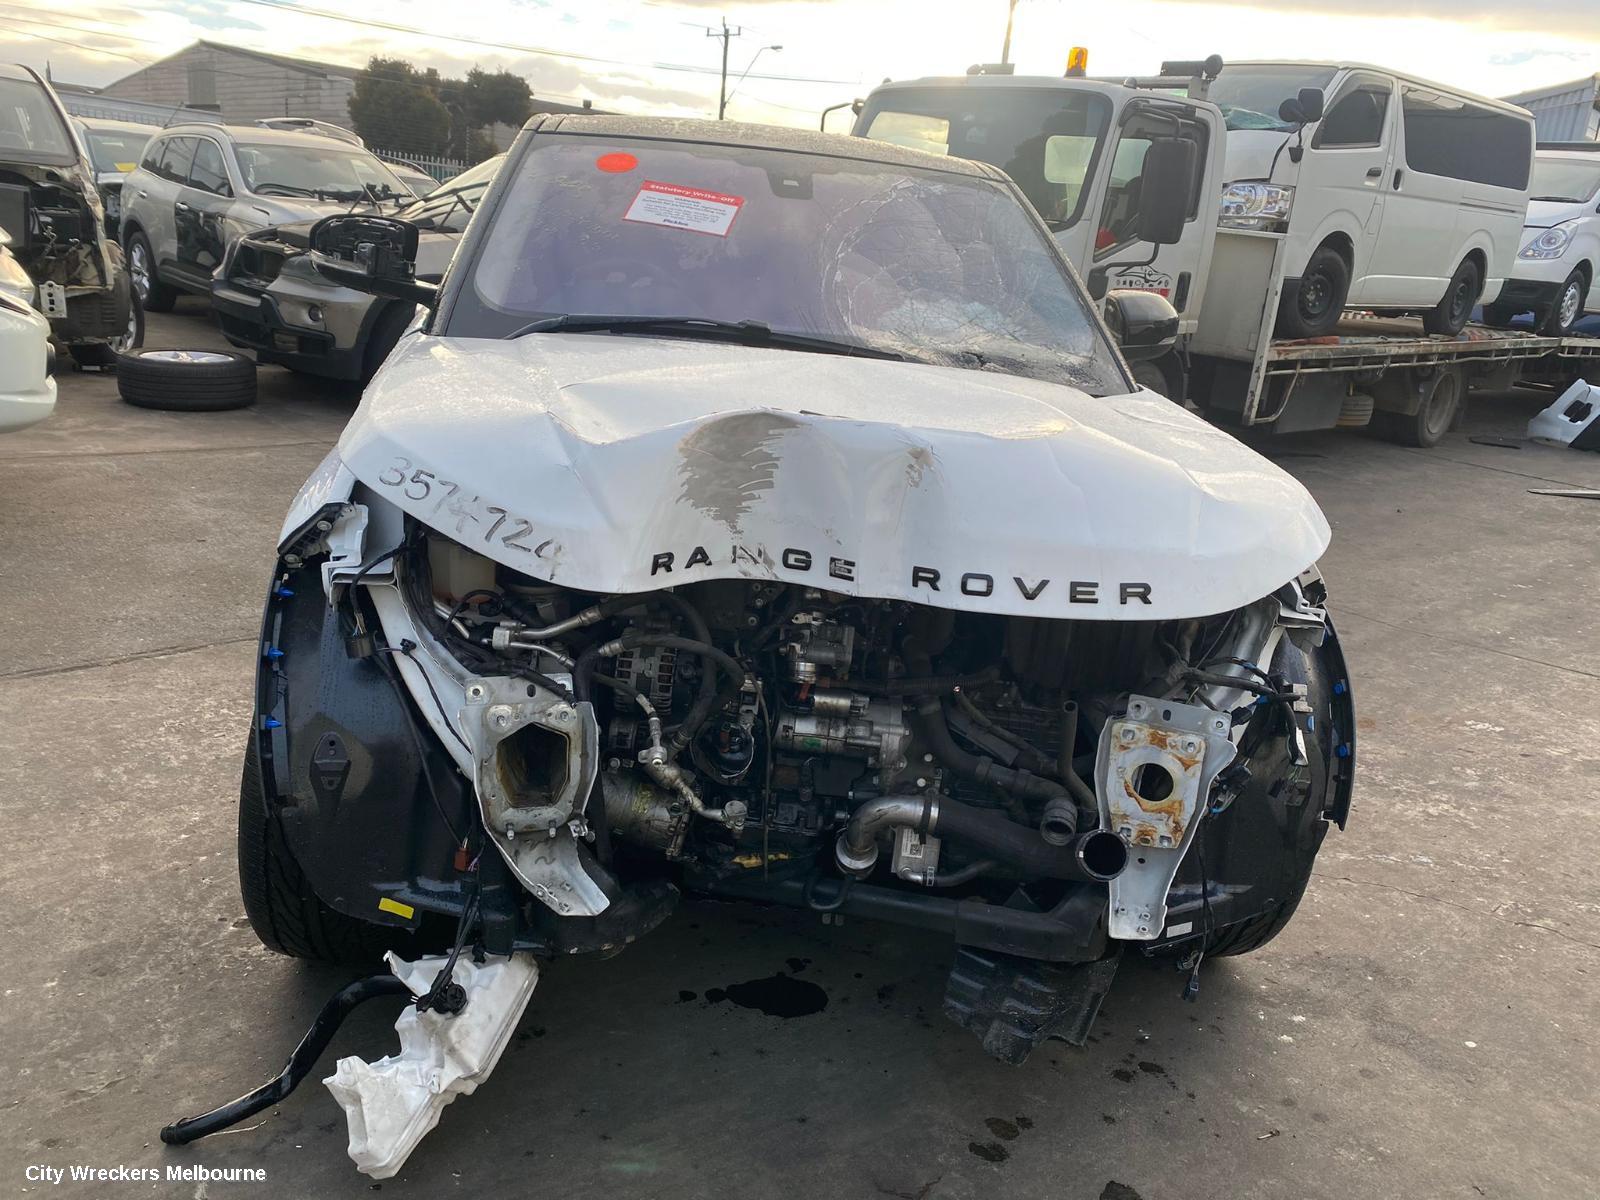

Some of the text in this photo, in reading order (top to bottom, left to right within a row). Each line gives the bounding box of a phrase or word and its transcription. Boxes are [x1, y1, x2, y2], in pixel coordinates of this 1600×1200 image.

[650, 184, 691, 195] Statutory
[651, 545, 1152, 605] RANGE ROVER
